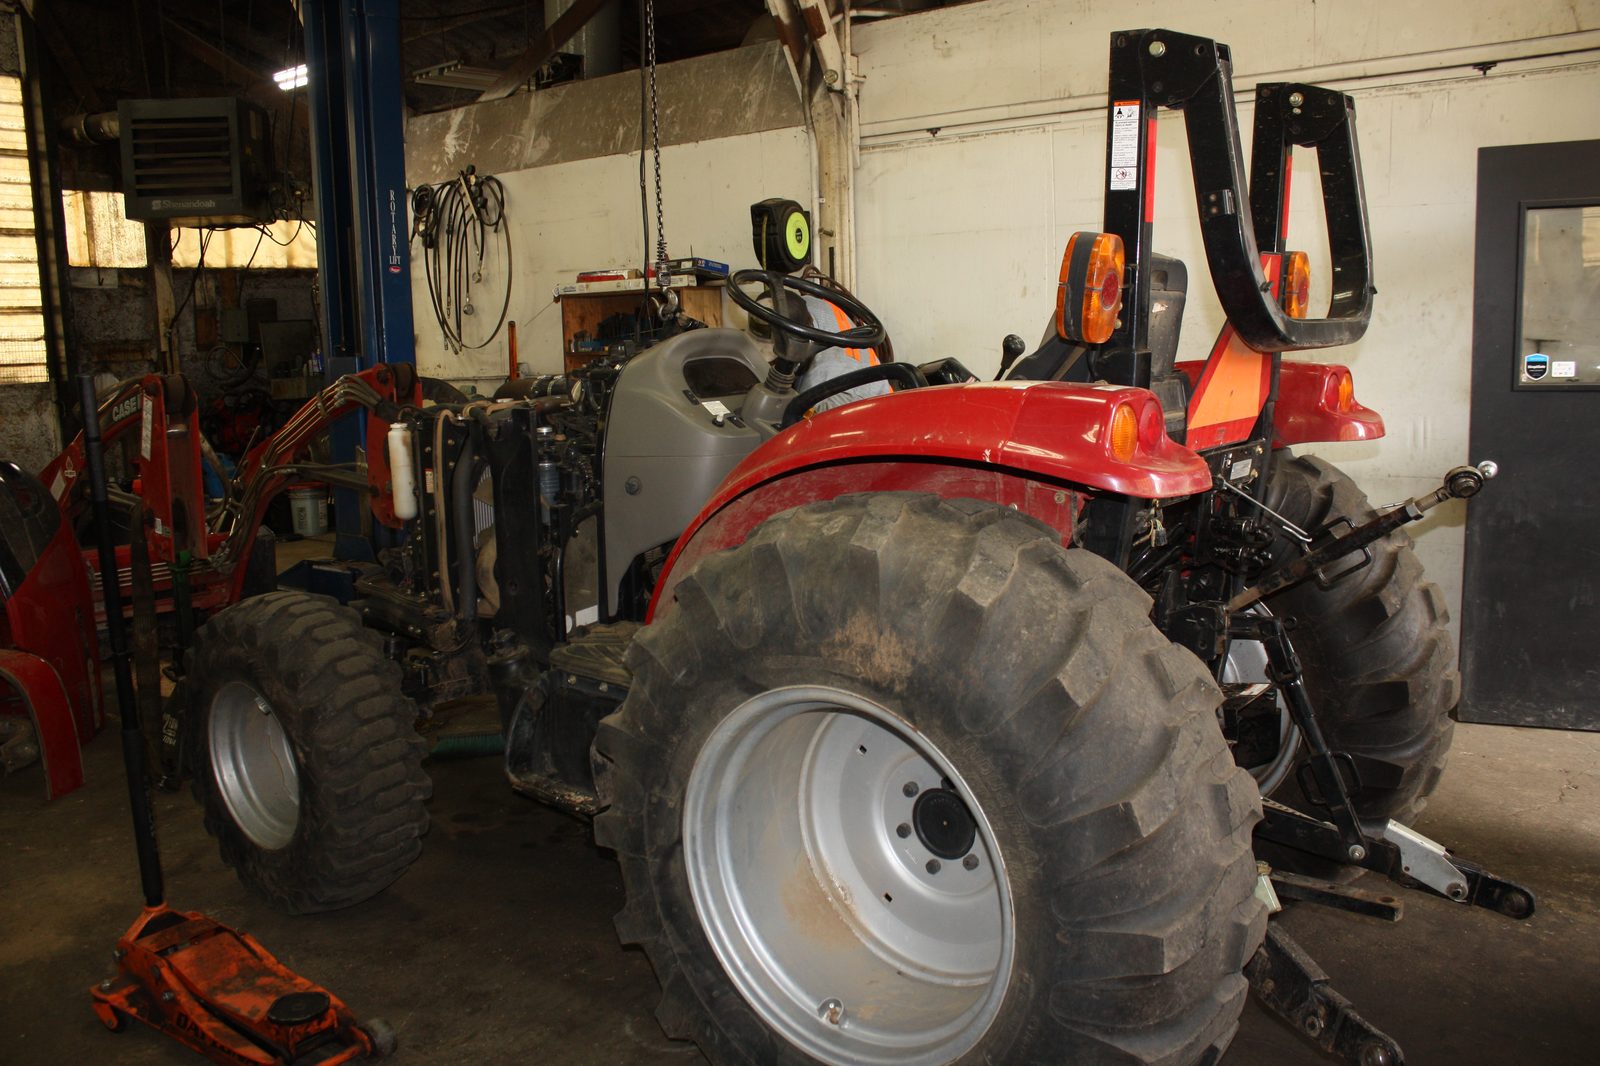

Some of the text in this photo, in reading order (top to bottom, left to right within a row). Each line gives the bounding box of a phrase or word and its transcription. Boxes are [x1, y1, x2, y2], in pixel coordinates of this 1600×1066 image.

[162, 199, 216, 209] Shenandoah
[389, 189, 397, 256] ROTARY
[389, 256, 401, 265] LIFT
[112, 396, 137, 422] CASE
